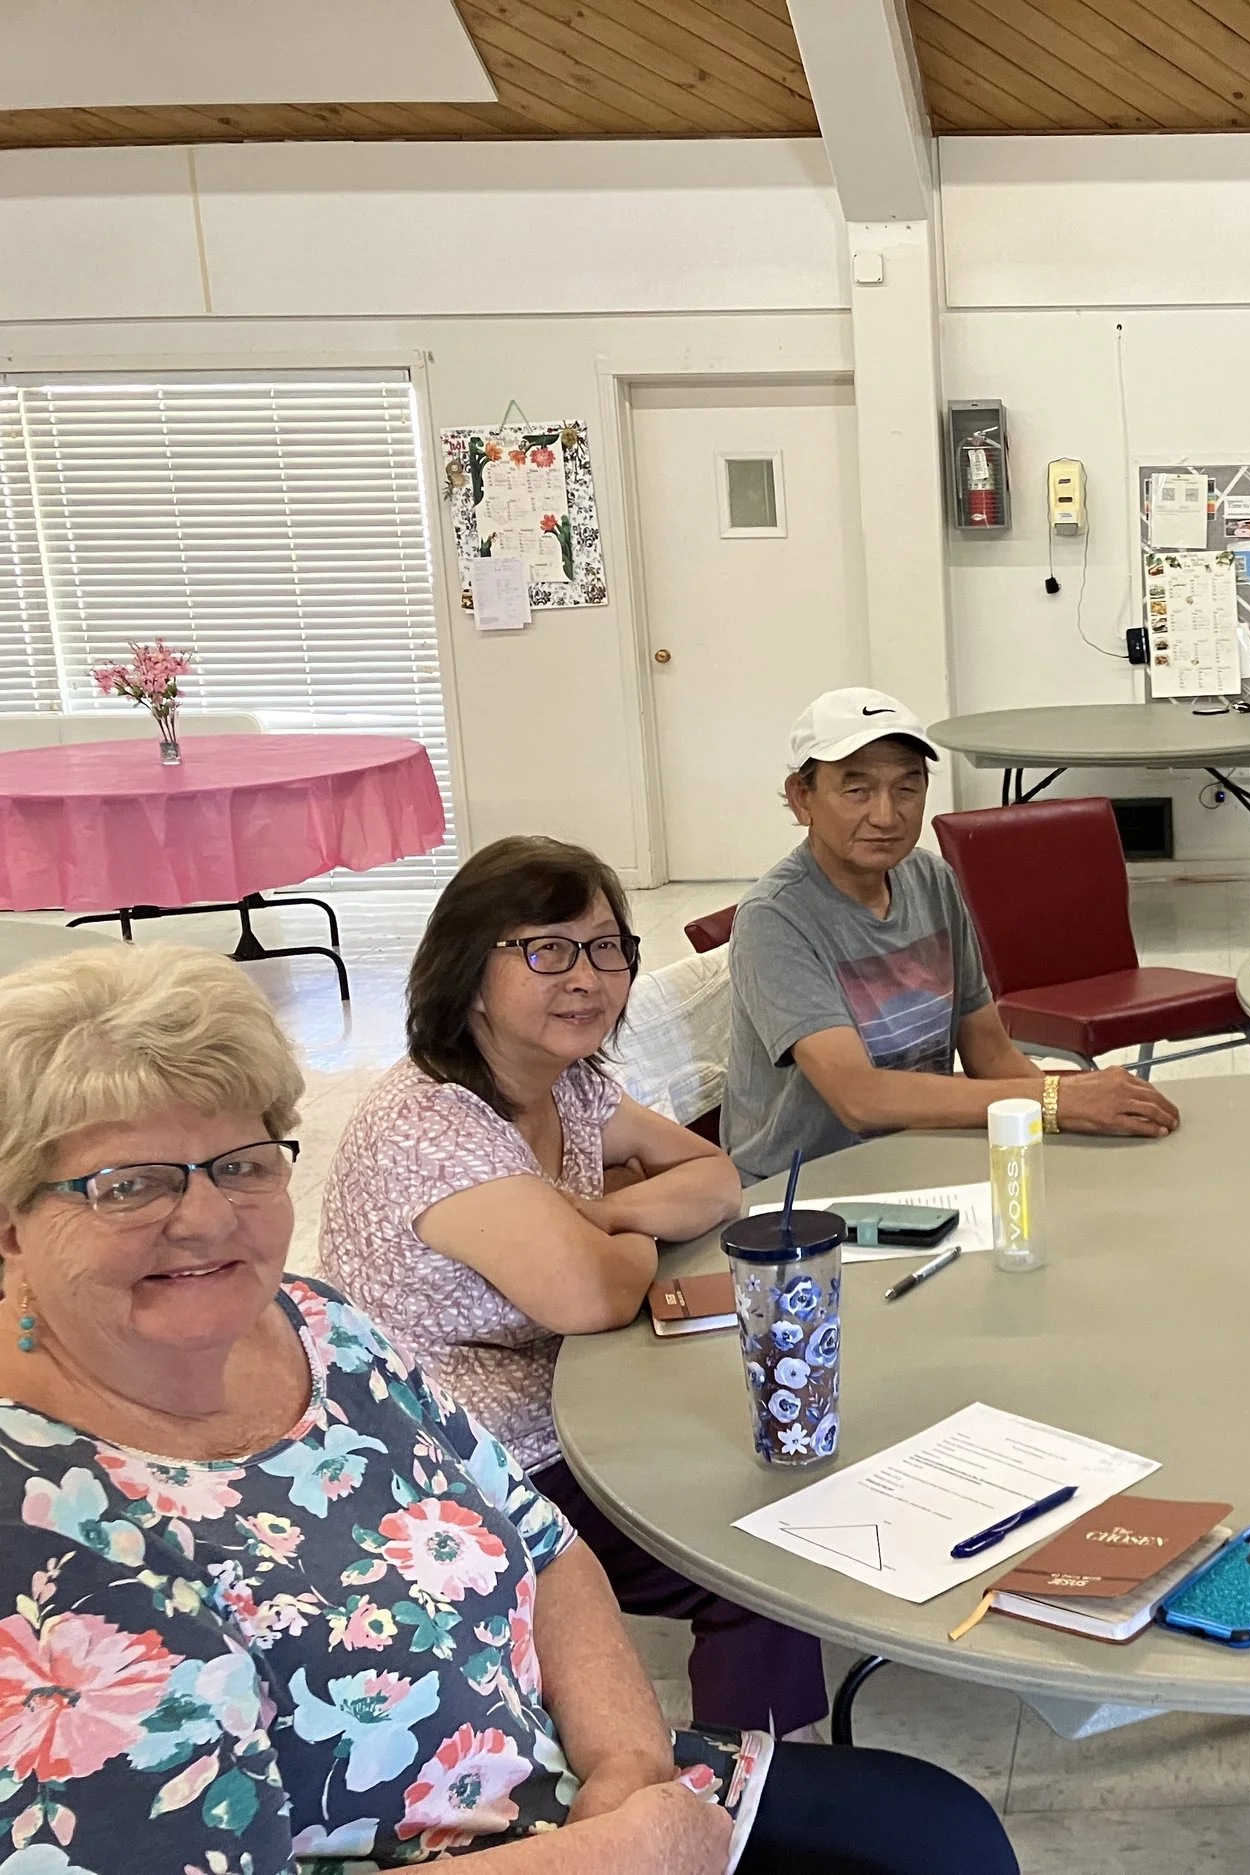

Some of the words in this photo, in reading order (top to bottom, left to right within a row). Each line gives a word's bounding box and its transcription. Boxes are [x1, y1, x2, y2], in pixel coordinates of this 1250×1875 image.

[1007, 1161, 1021, 1241] VOSS
[1113, 1526, 1133, 1535] The
[1085, 1531, 1170, 1547] CHOSEN
